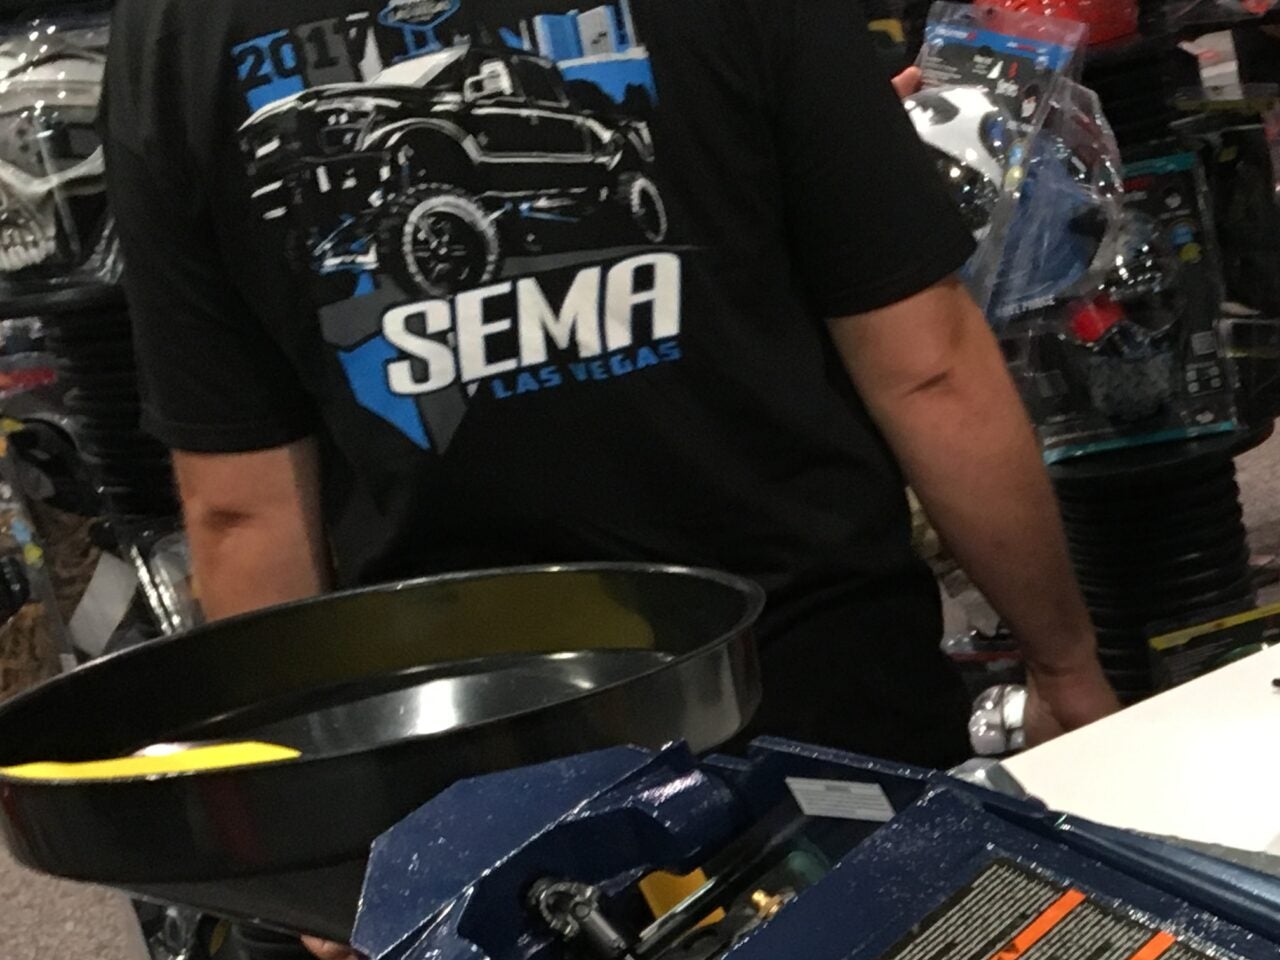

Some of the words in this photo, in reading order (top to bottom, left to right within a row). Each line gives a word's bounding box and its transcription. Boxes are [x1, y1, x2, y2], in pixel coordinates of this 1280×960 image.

[382, 252, 681, 395] SEMA
[491, 365, 563, 399] LAS
[569, 341, 682, 381] VEGAS
